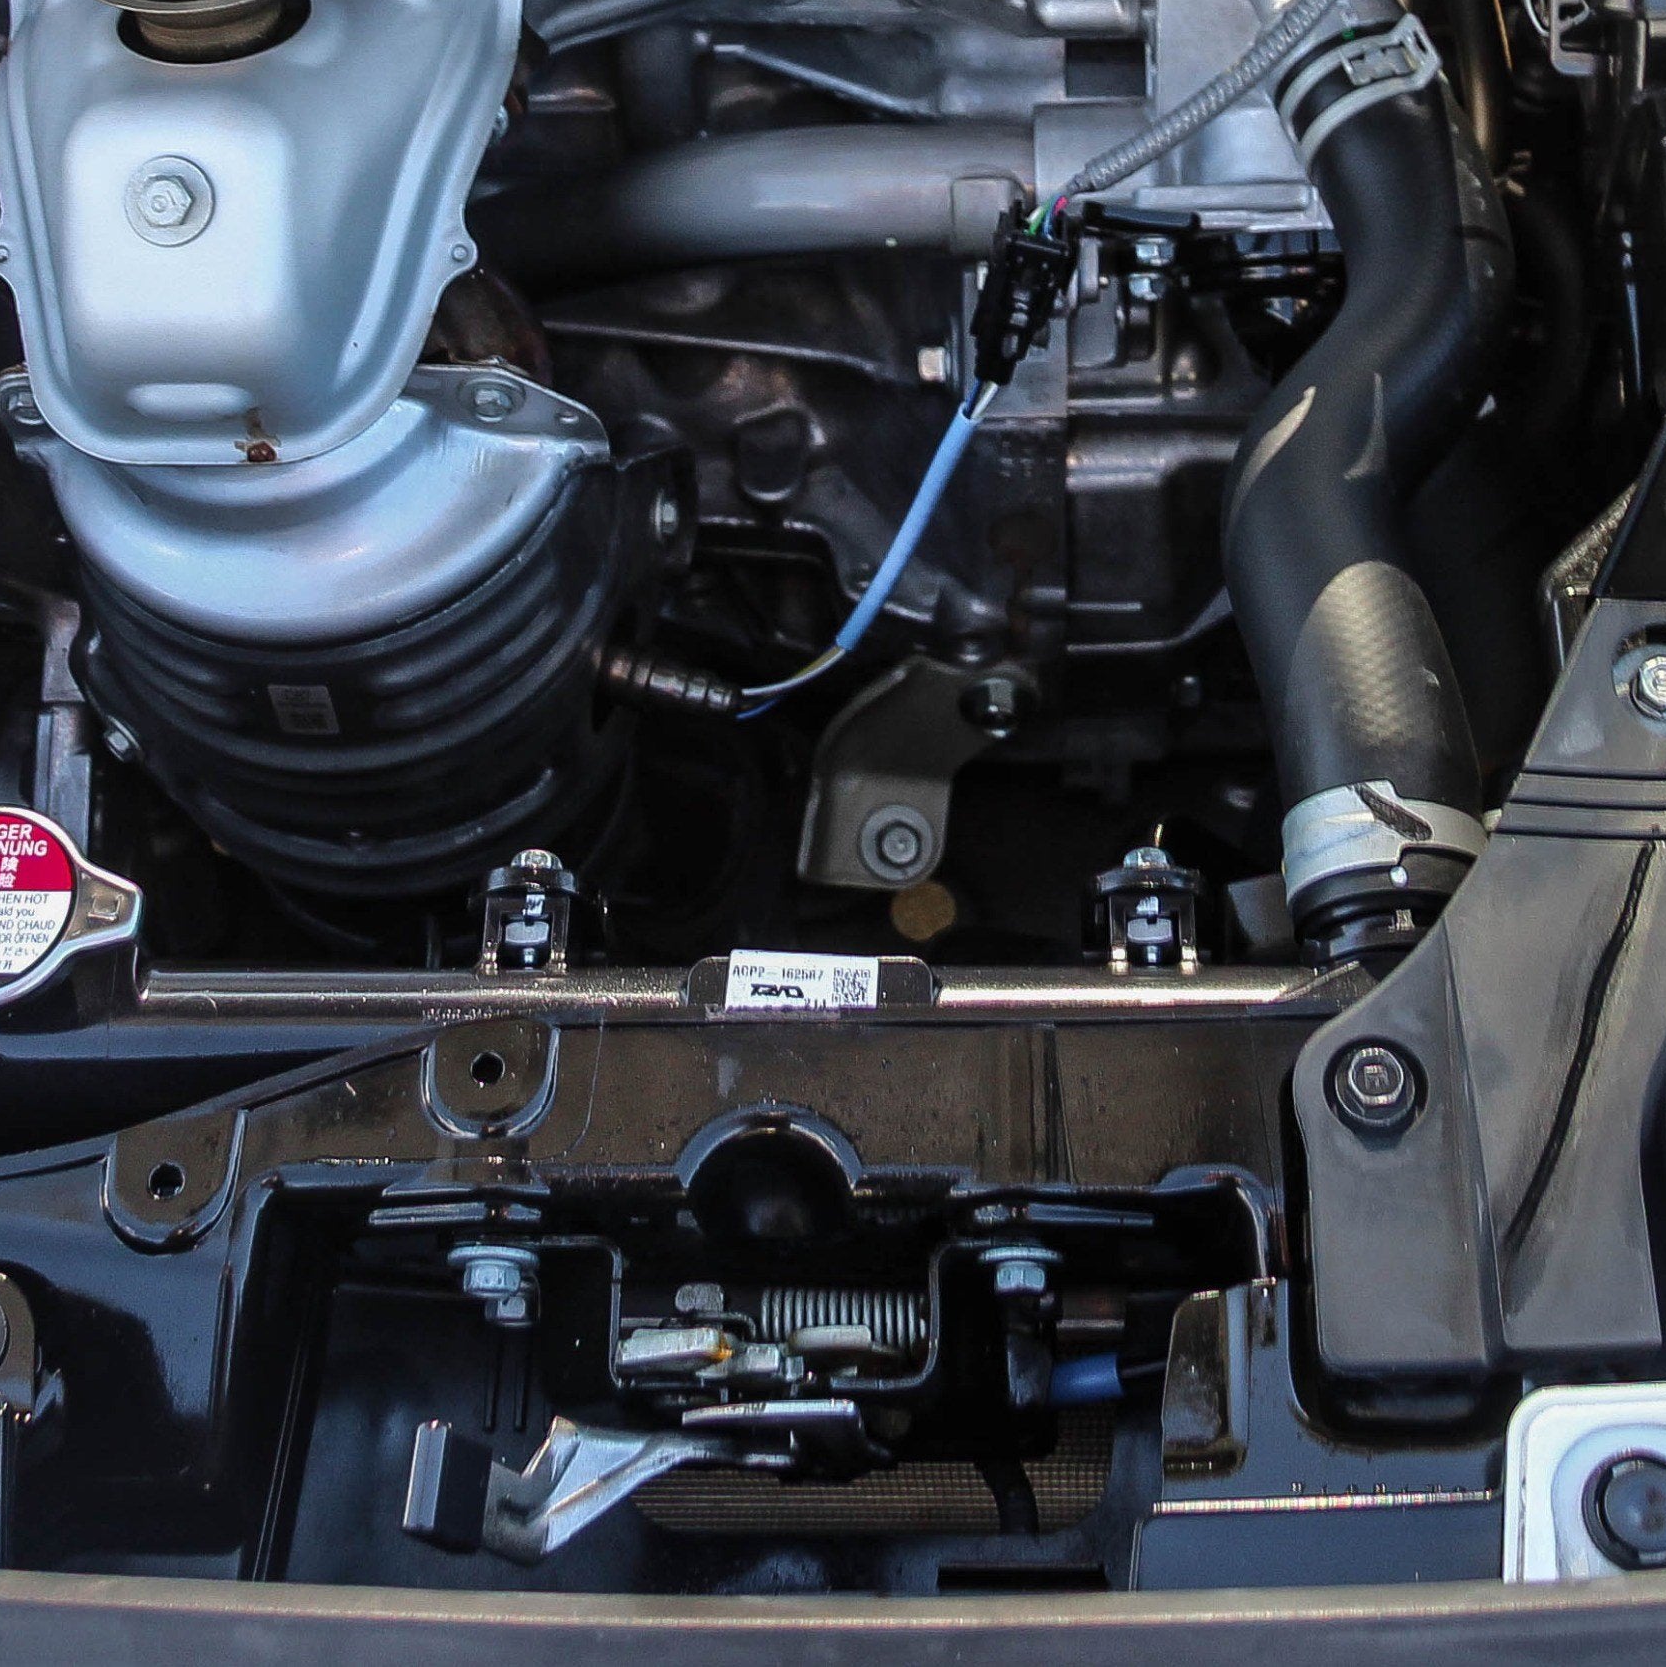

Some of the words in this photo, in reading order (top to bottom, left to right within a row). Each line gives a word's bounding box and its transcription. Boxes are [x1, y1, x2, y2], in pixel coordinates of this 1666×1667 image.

[25, 894, 49, 905] HOT
[15, 909, 36, 919] you
[16, 919, 56, 931] CHAUD
